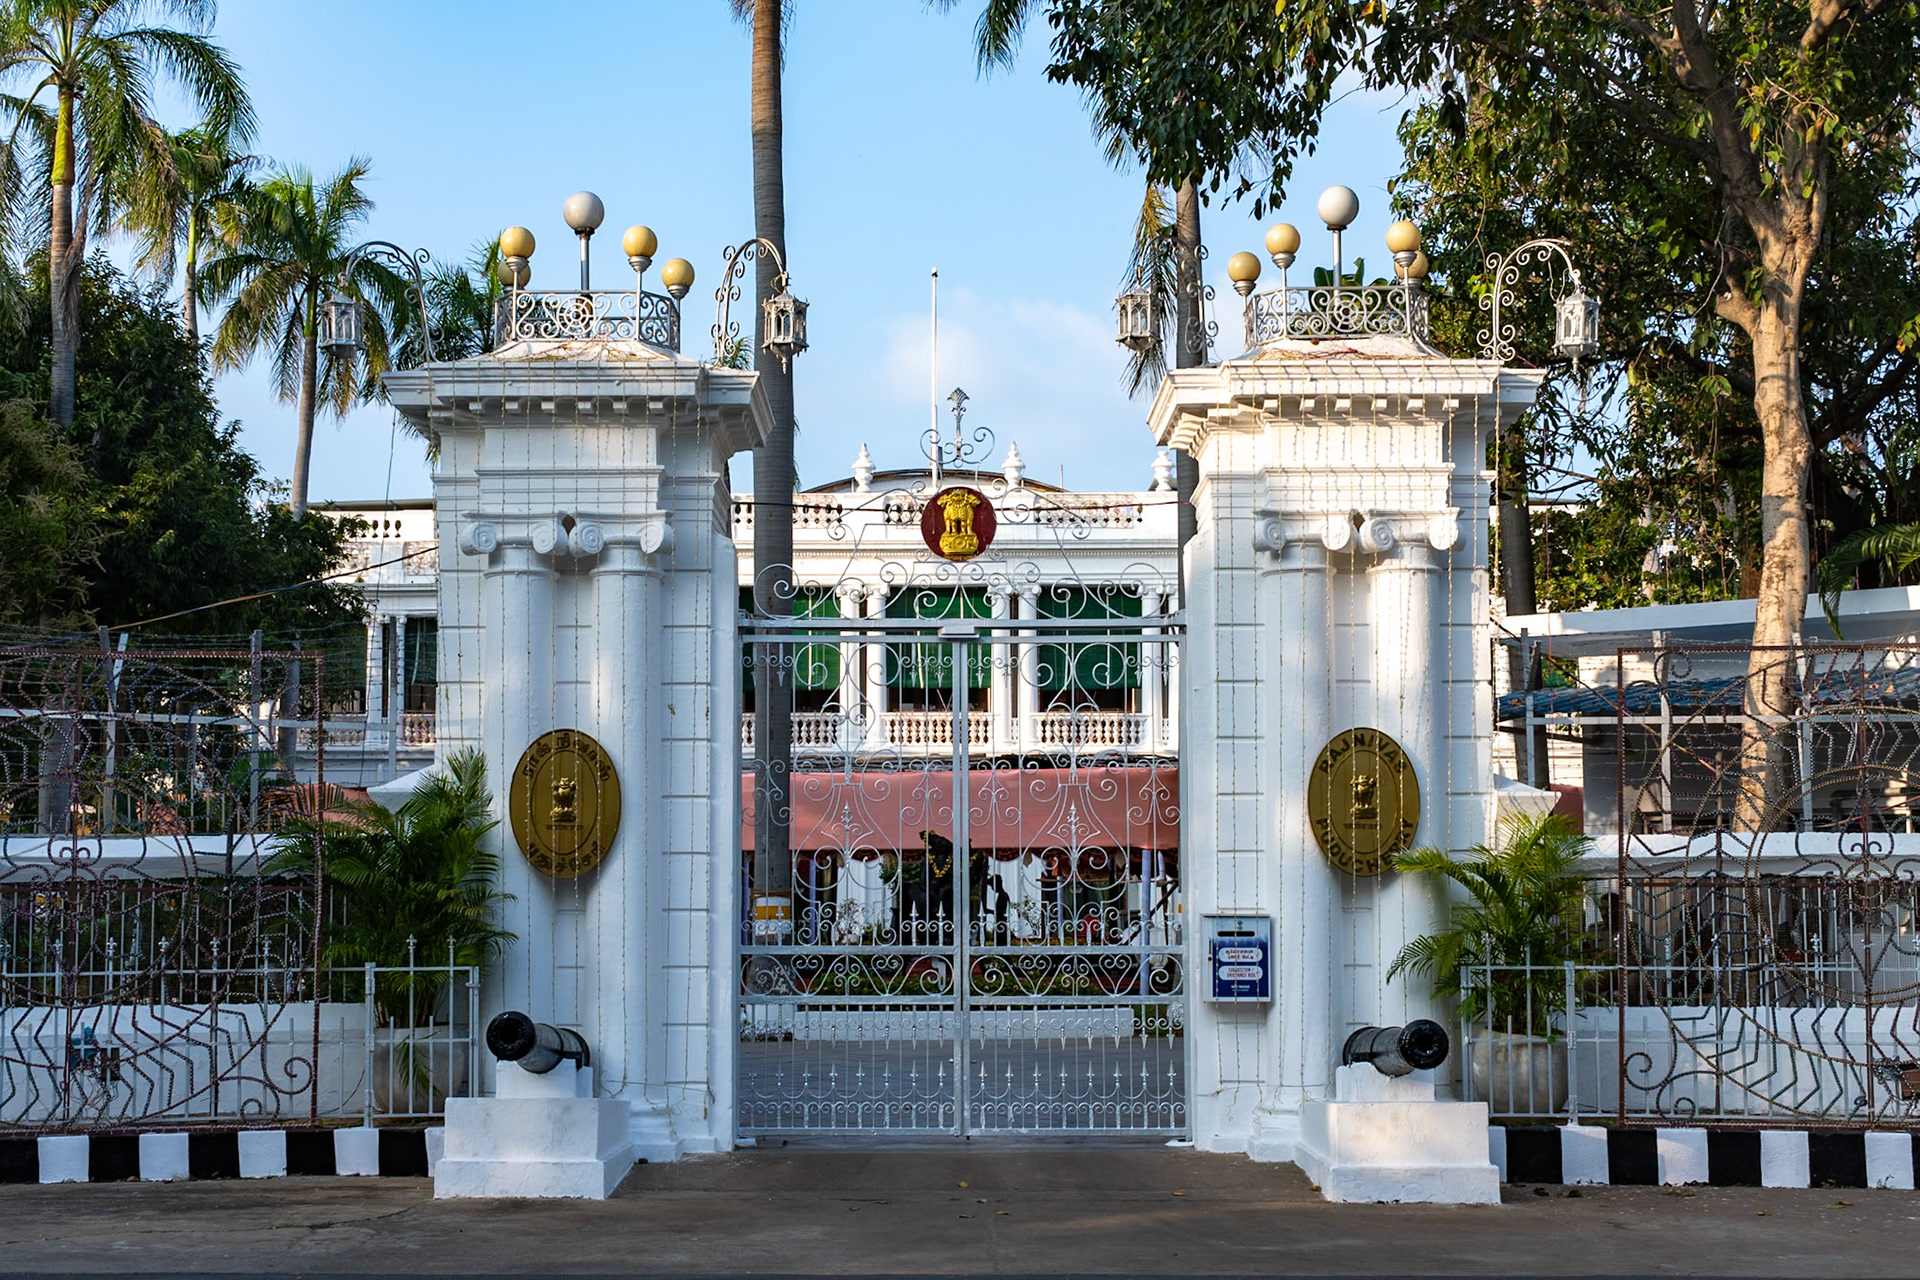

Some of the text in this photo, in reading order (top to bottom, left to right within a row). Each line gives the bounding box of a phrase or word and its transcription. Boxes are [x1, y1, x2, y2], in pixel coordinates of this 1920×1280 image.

[1318, 733, 1407, 774] RAJ NIVAS
[1316, 817, 1413, 873] PUDUCHERRY
